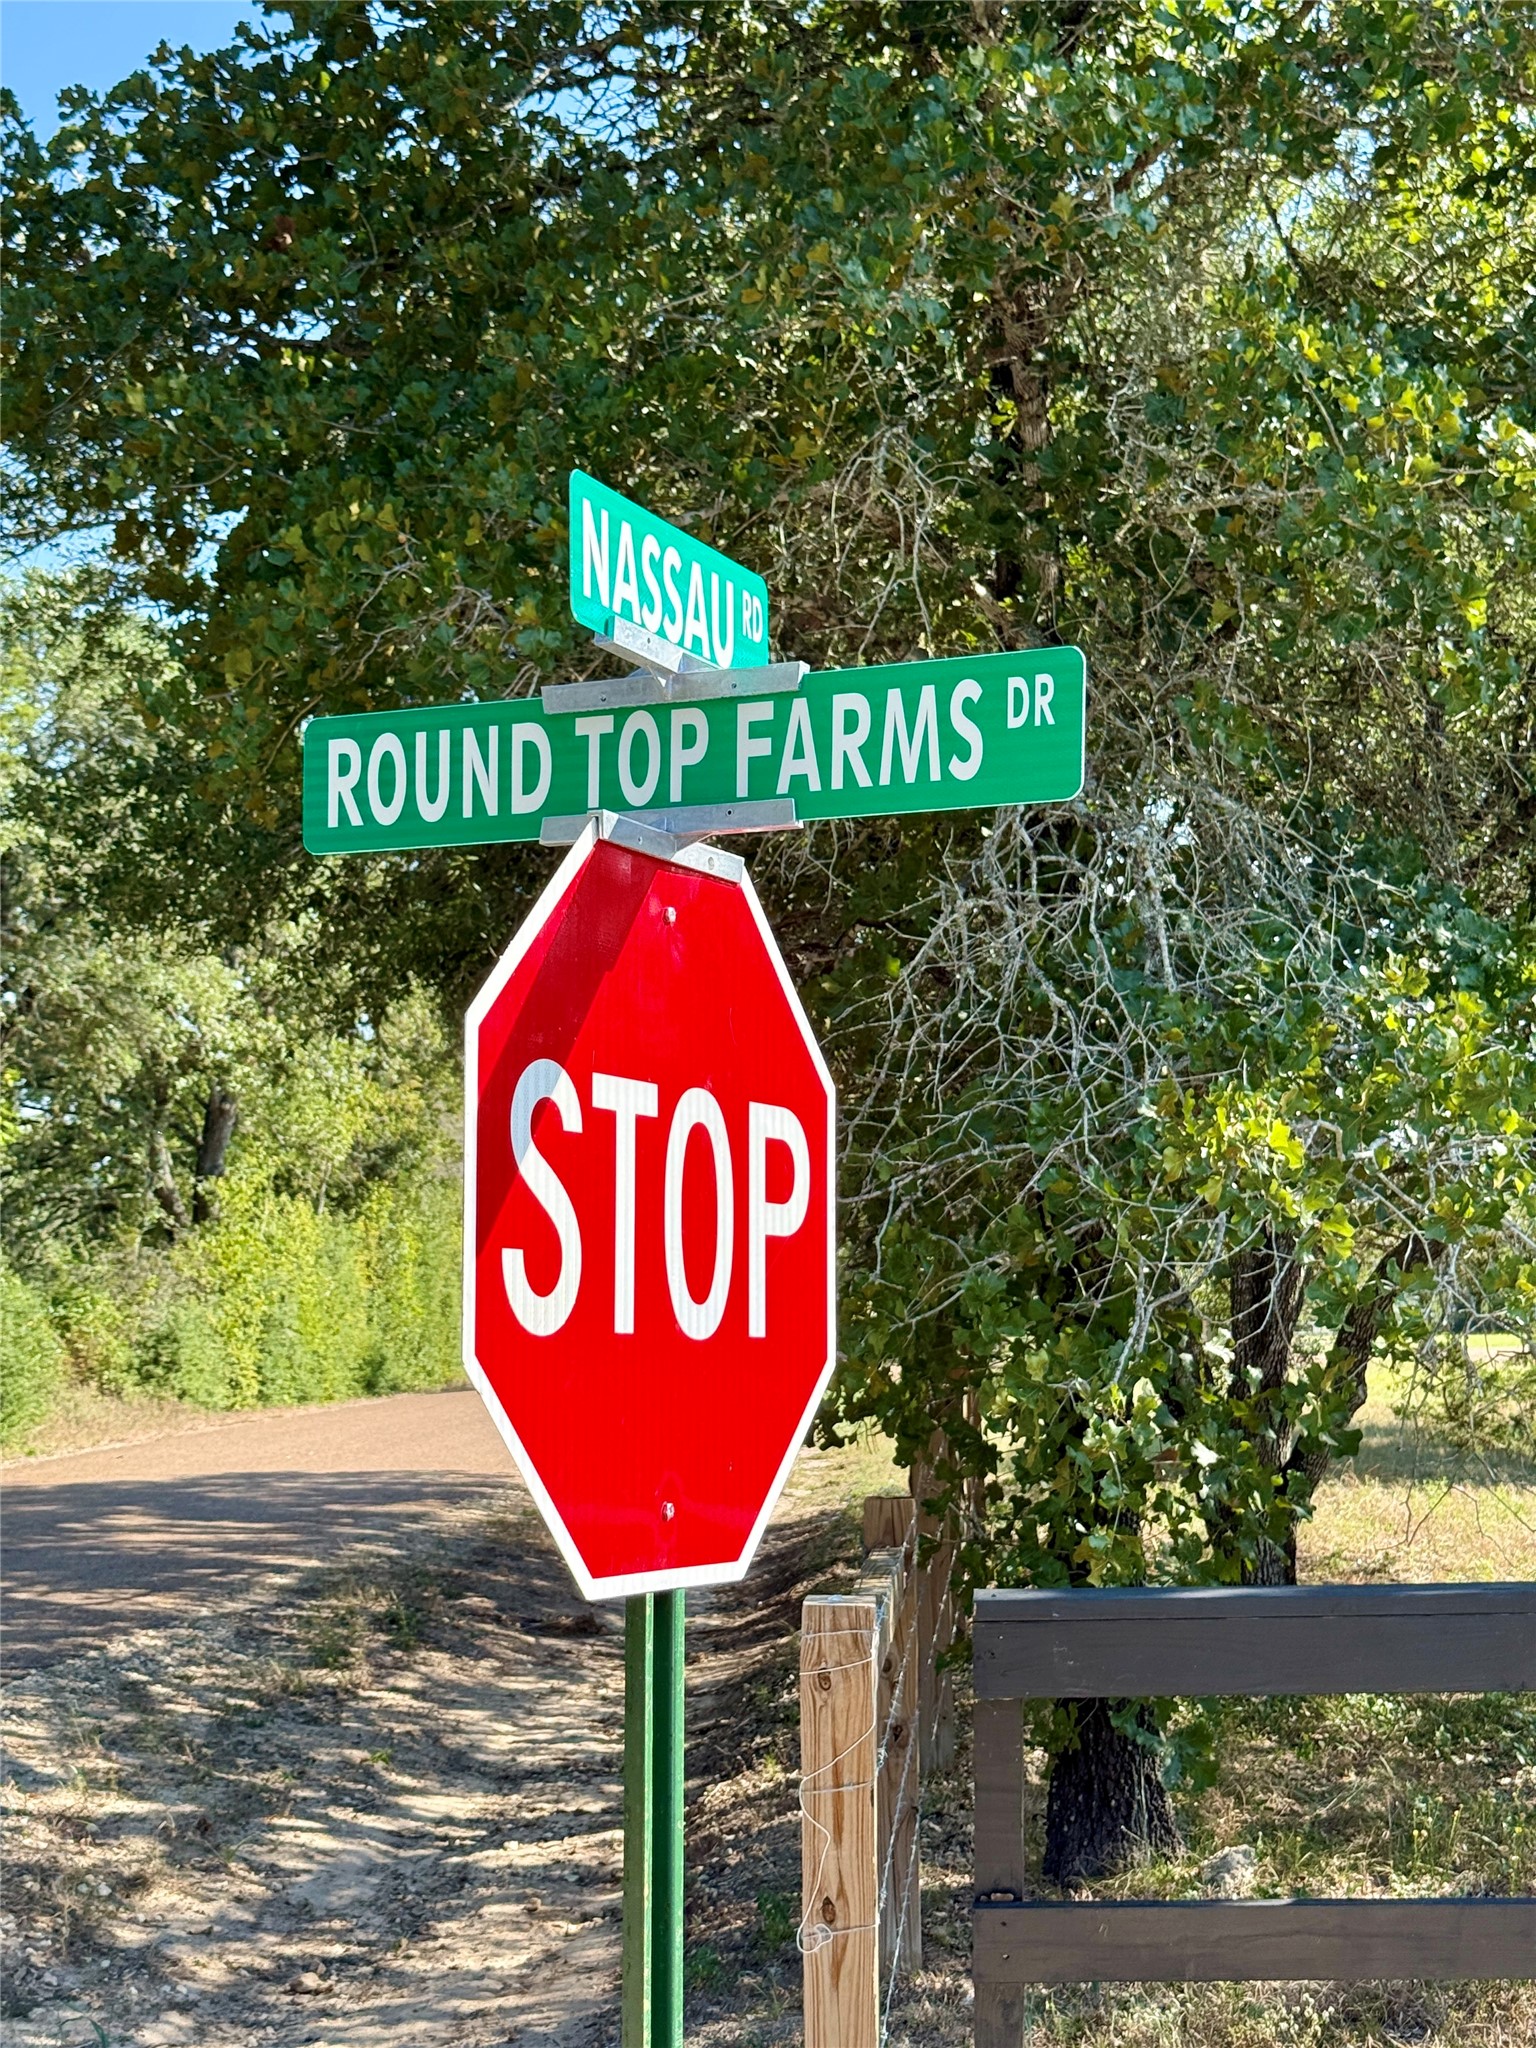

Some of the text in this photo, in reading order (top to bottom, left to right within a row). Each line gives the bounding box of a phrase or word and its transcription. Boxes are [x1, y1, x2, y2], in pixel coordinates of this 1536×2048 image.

[581, 499, 764, 668] NASSAU RD
[327, 673, 1056, 829] ROUND TOP FARMS DR
[501, 1058, 811, 1341] STOP
